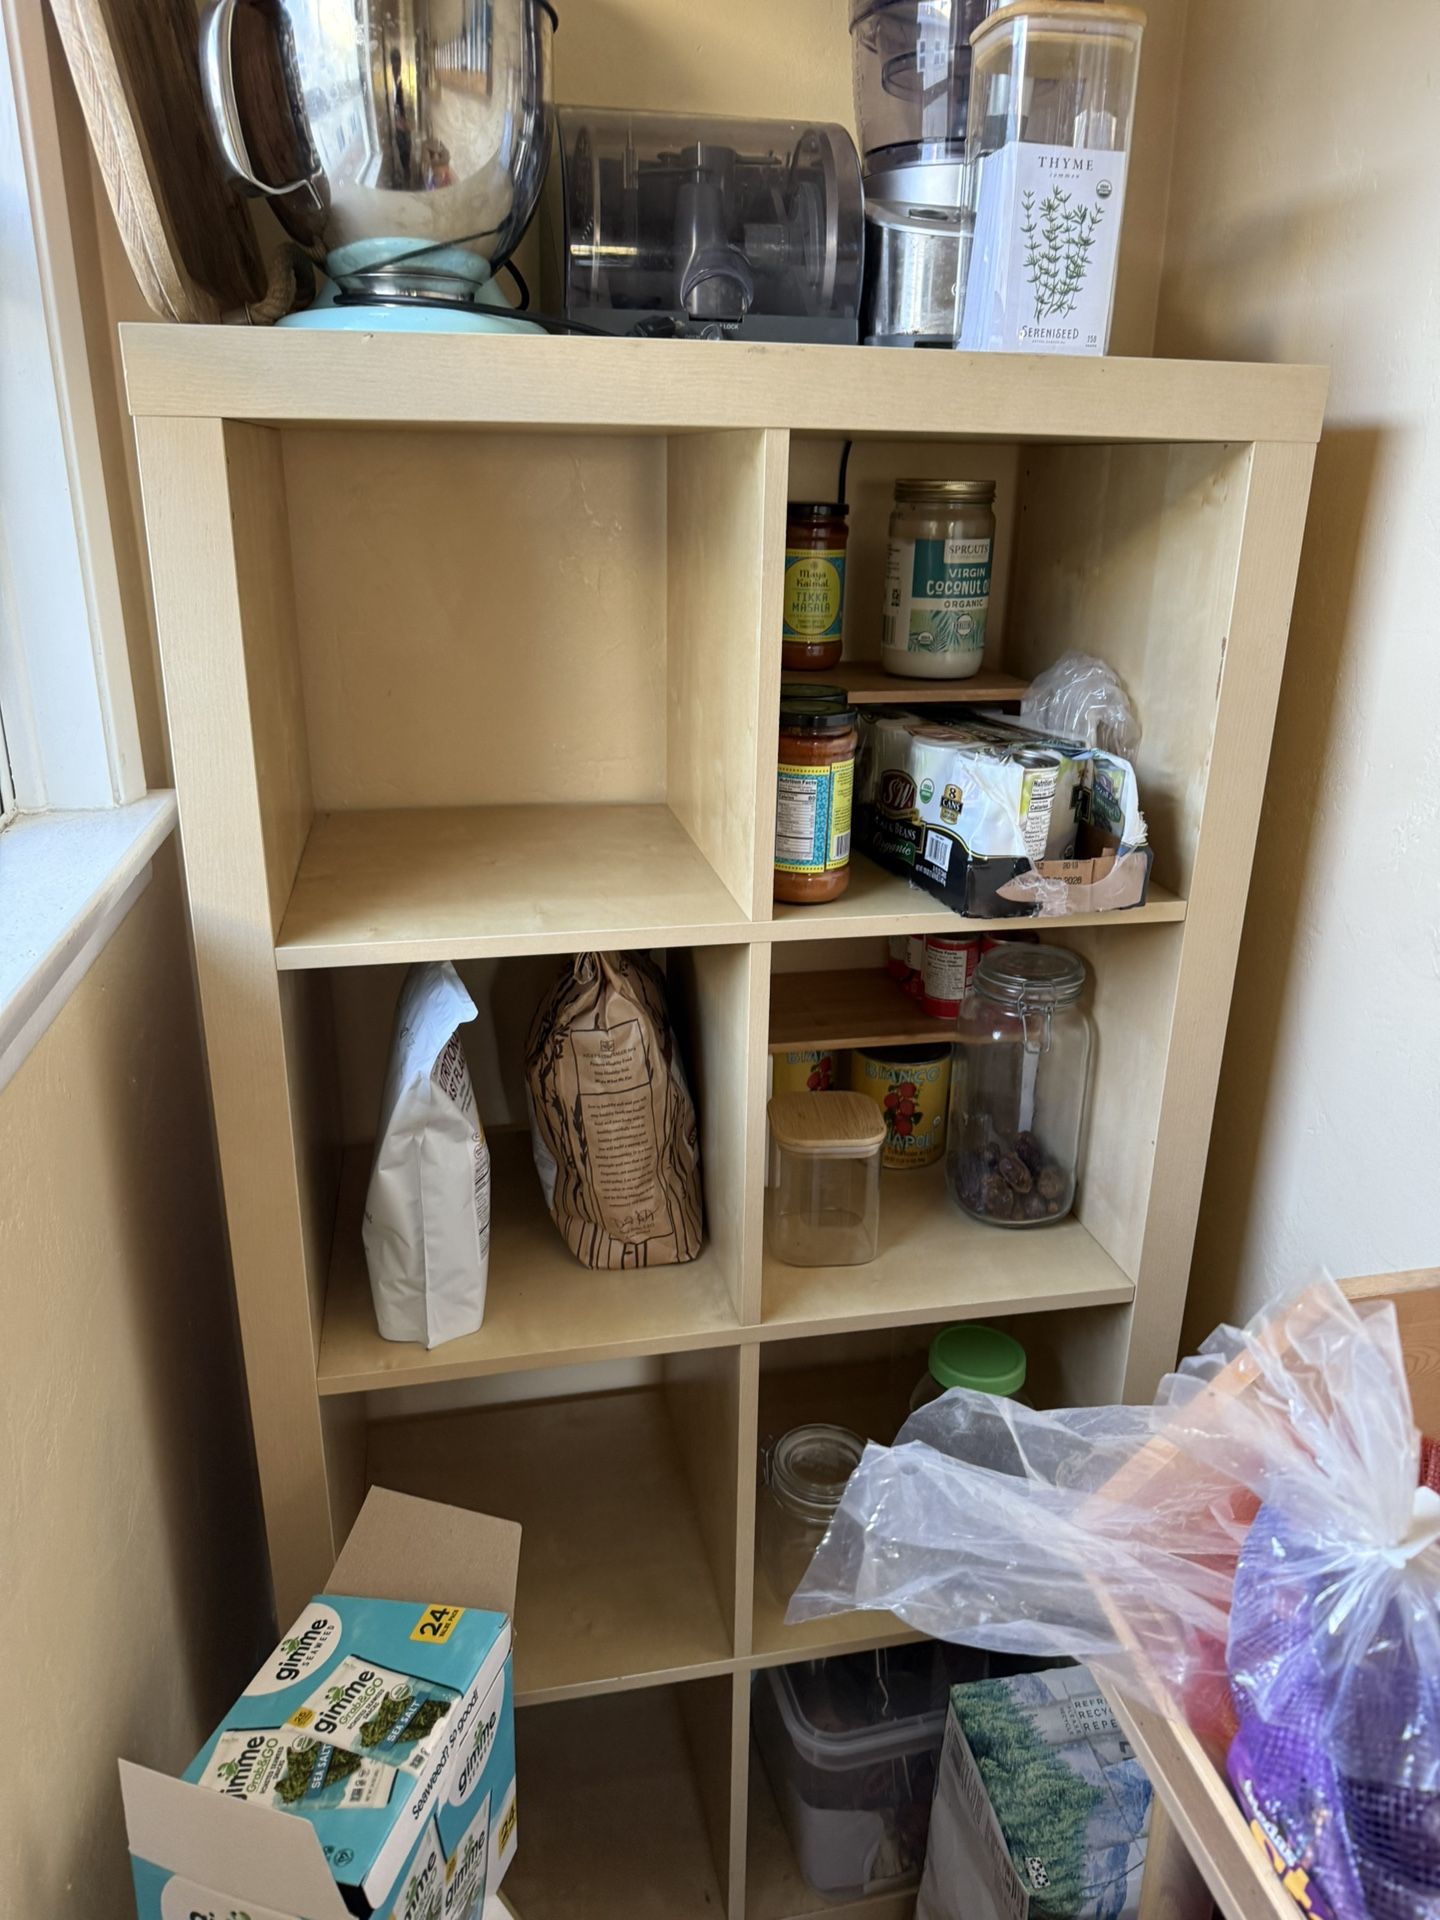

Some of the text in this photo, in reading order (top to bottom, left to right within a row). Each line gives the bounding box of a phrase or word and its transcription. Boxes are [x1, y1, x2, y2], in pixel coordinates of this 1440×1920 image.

[1038, 155, 1094, 171] THYME
[1021, 324, 1080, 340] SERENISEED
[949, 543, 989, 555] SPROUTS
[948, 567, 986, 578] VIRGIN
[796, 591, 829, 602] TIKKA
[926, 579, 981, 596] COCONUT
[791, 601, 831, 613] MASALA
[943, 598, 984, 609] ORGANIC
[942, 798, 960, 812] CANS
[949, 787, 957, 800] 8
[895, 822, 917, 841] BEANS
[864, 1062, 940, 1084] BIANCO
[419, 1607, 450, 1637] 24
[275, 1618, 328, 1681] gimme
[301, 1625, 335, 1667] SEAWEED
[314, 1669, 375, 1734] gimme
[339, 1677, 384, 1725] Grab&GO
[387, 1701, 421, 1742] SEA SALT
[245, 1737, 279, 1794] Grab&GO
[311, 1743, 333, 1790] SEA SALT
[458, 1711, 497, 1798] gimme
[219, 1735, 266, 1801] imme
[411, 1745, 450, 1821] Seaweed?
[448, 1728, 458, 1749] So
[444, 1830, 485, 1917] gimme
